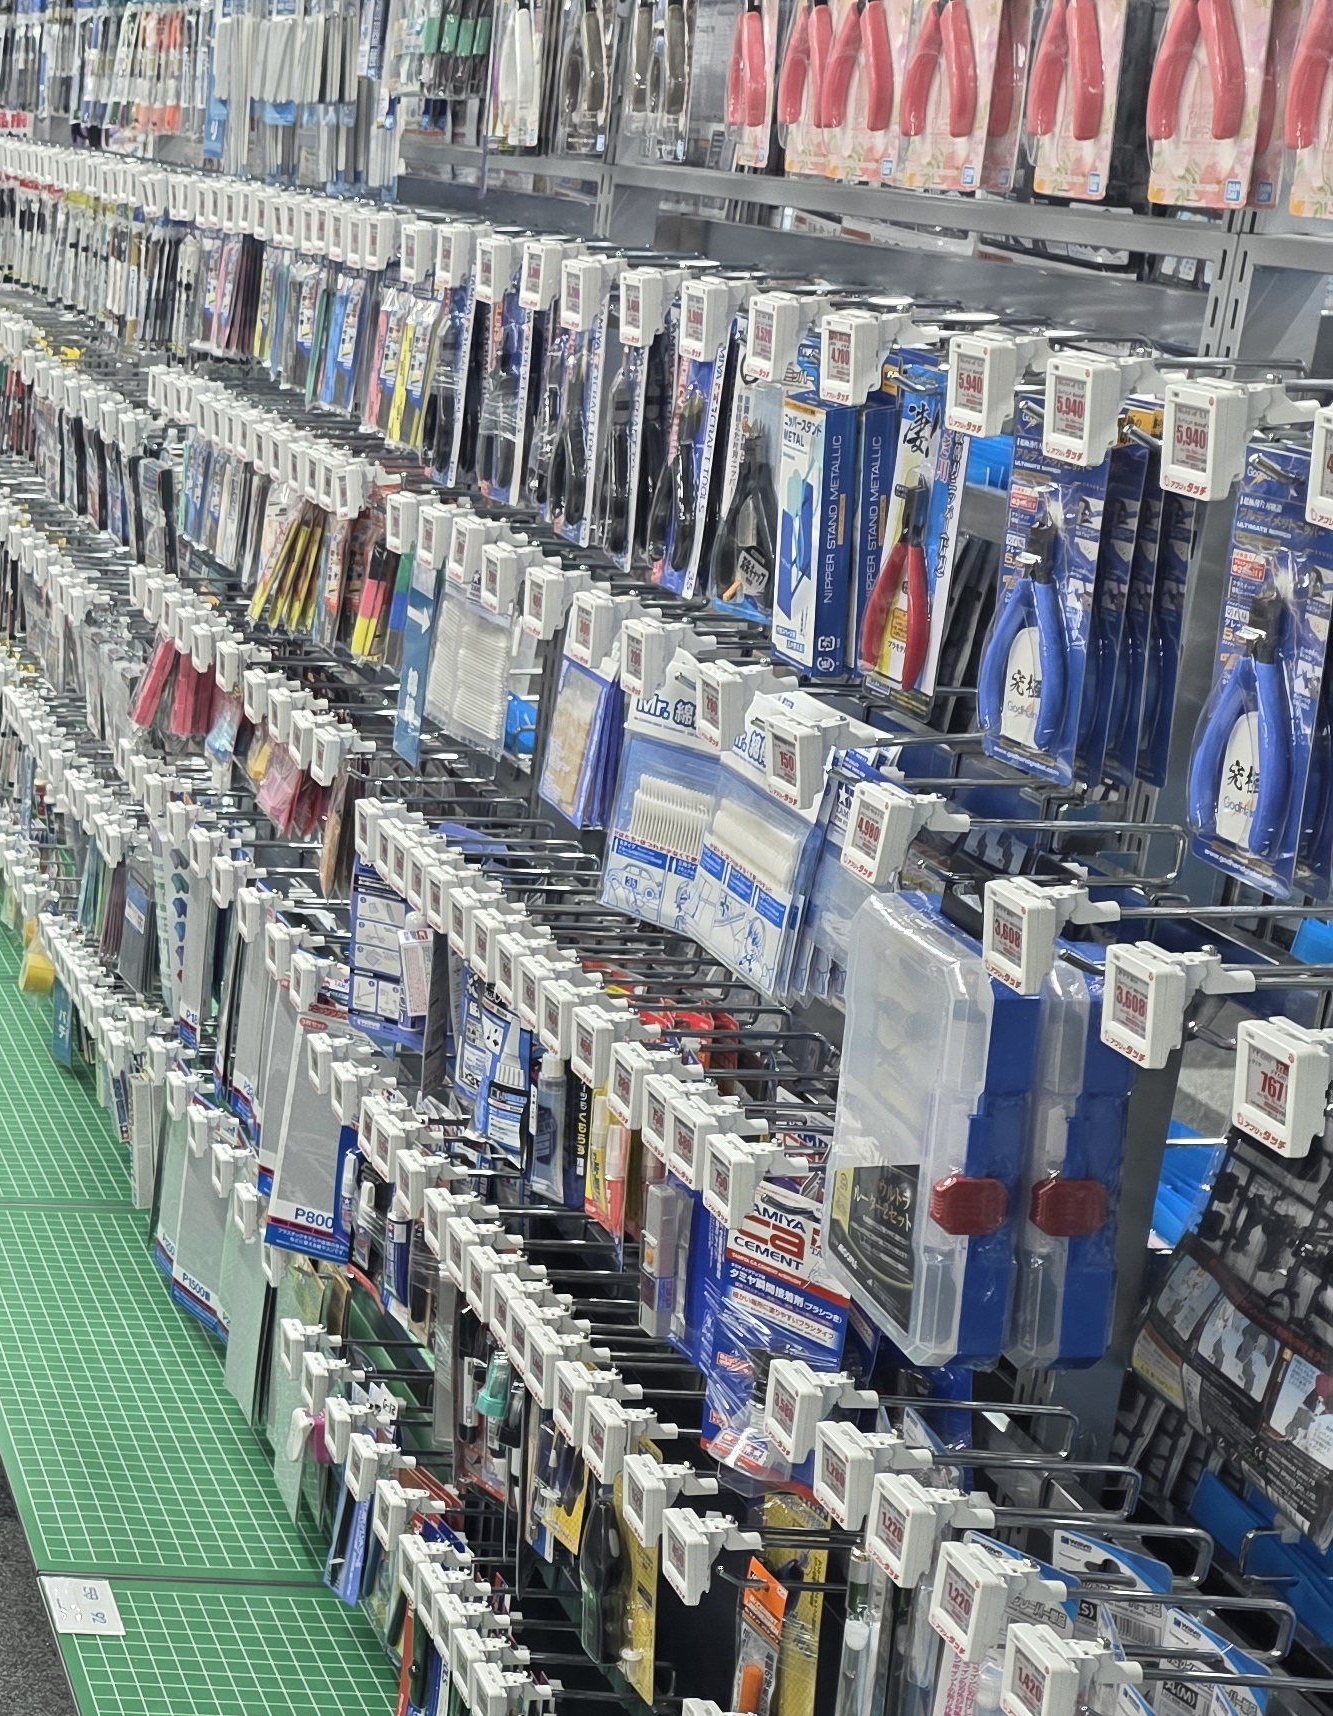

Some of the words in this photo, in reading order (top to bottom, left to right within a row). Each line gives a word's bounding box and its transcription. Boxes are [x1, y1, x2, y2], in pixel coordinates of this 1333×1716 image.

[957, 374, 984, 397] 5,940
[1057, 396, 1083, 418] 5,940
[784, 430, 805, 447] METAL
[1176, 425, 1207, 448] 5,940
[829, 435, 842, 502] METALLIC
[870, 436, 882, 502] METALLIC
[828, 504, 838, 549] STAND
[869, 505, 878, 550] STAND
[824, 553, 835, 603] NIPPER
[674, 699, 696, 727] 綿
[779, 751, 795, 773] 150
[858, 817, 879, 841] 4,980
[1116, 983, 1147, 1018] 3,608
[1260, 1070, 1284, 1104] 767
[295, 1207, 334, 1229] P800
[754, 1204, 807, 1234] AMIYA
[734, 1235, 804, 1271] CEMENT
